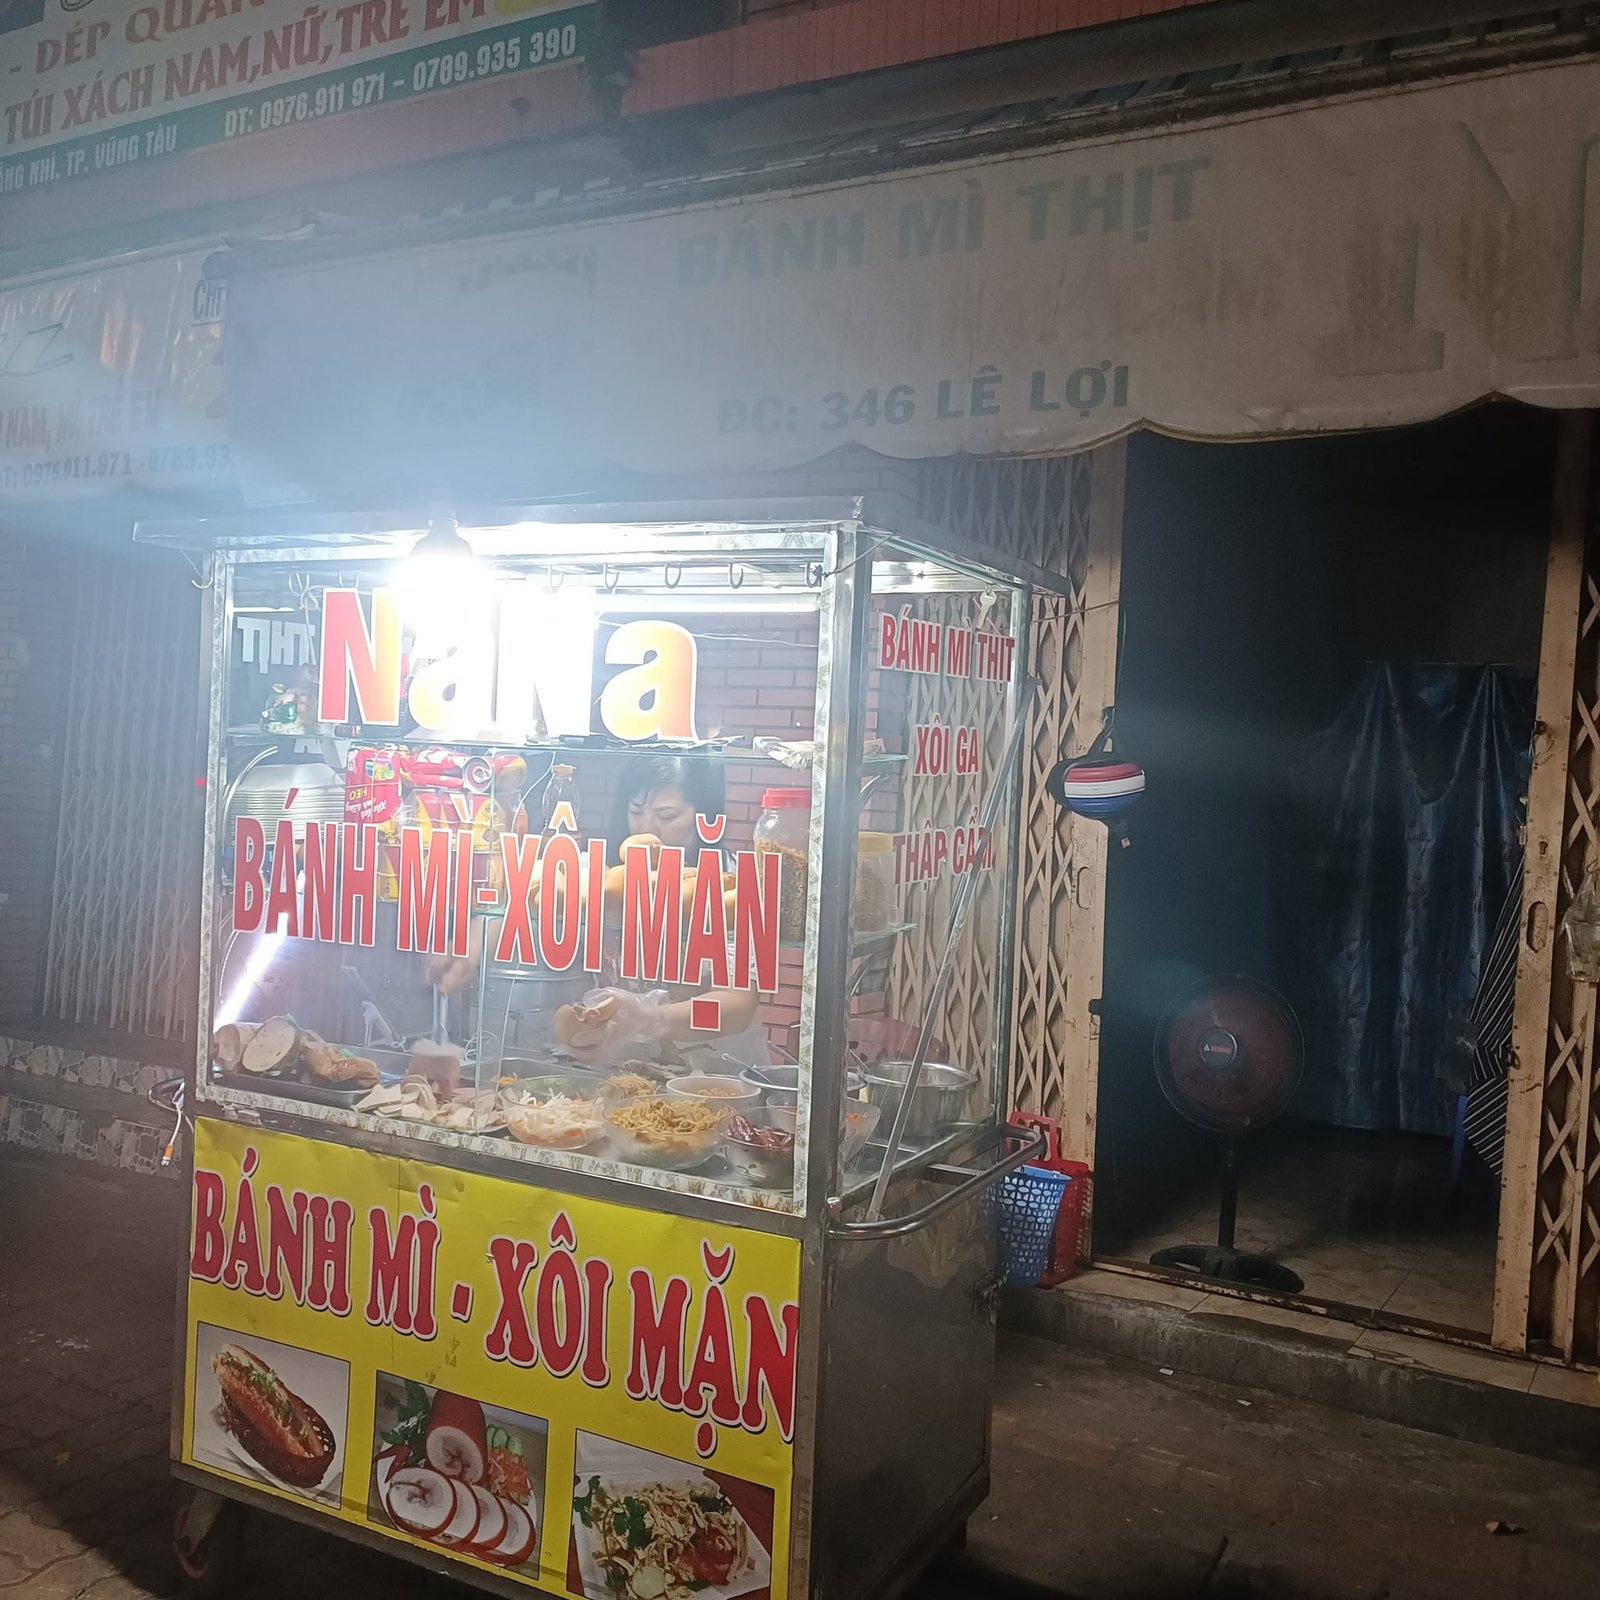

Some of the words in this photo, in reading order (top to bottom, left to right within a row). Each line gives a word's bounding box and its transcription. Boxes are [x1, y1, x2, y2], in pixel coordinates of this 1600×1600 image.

[36, 22, 111, 74] DÉP
[224, 106, 253, 138] ĐT:
[260, 82, 344, 129] 0976.911
[352, 72, 385, 106] 971
[413, 37, 521, 91] 0789.935
[529, 24, 576, 63] 390
[4, 88, 54, 144] TÚI
[61, 70, 156, 130] XÁCH
[677, 210, 866, 287] BÁNH
[896, 178, 986, 262] MÌ
[1015, 157, 1212, 243] THỊT
[820, 384, 916, 431] 346
[936, 365, 1003, 419] LÊ
[1030, 359, 1131, 418] LỢI
[879, 604, 942, 675] BÁNH
[946, 615, 973, 678] MÌ
[914, 712, 950, 777] XÔI
[955, 726, 980, 776] GA
[892, 818, 948, 891] THẬP
[232, 788, 380, 948] BÁNH
[620, 813, 783, 1032] MẶN
[190, 1146, 355, 1316] BÁNH
[366, 1185, 441, 1341] MÌ
[483, 1211, 614, 1386] XÔI
[626, 1239, 800, 1457] MẶN
